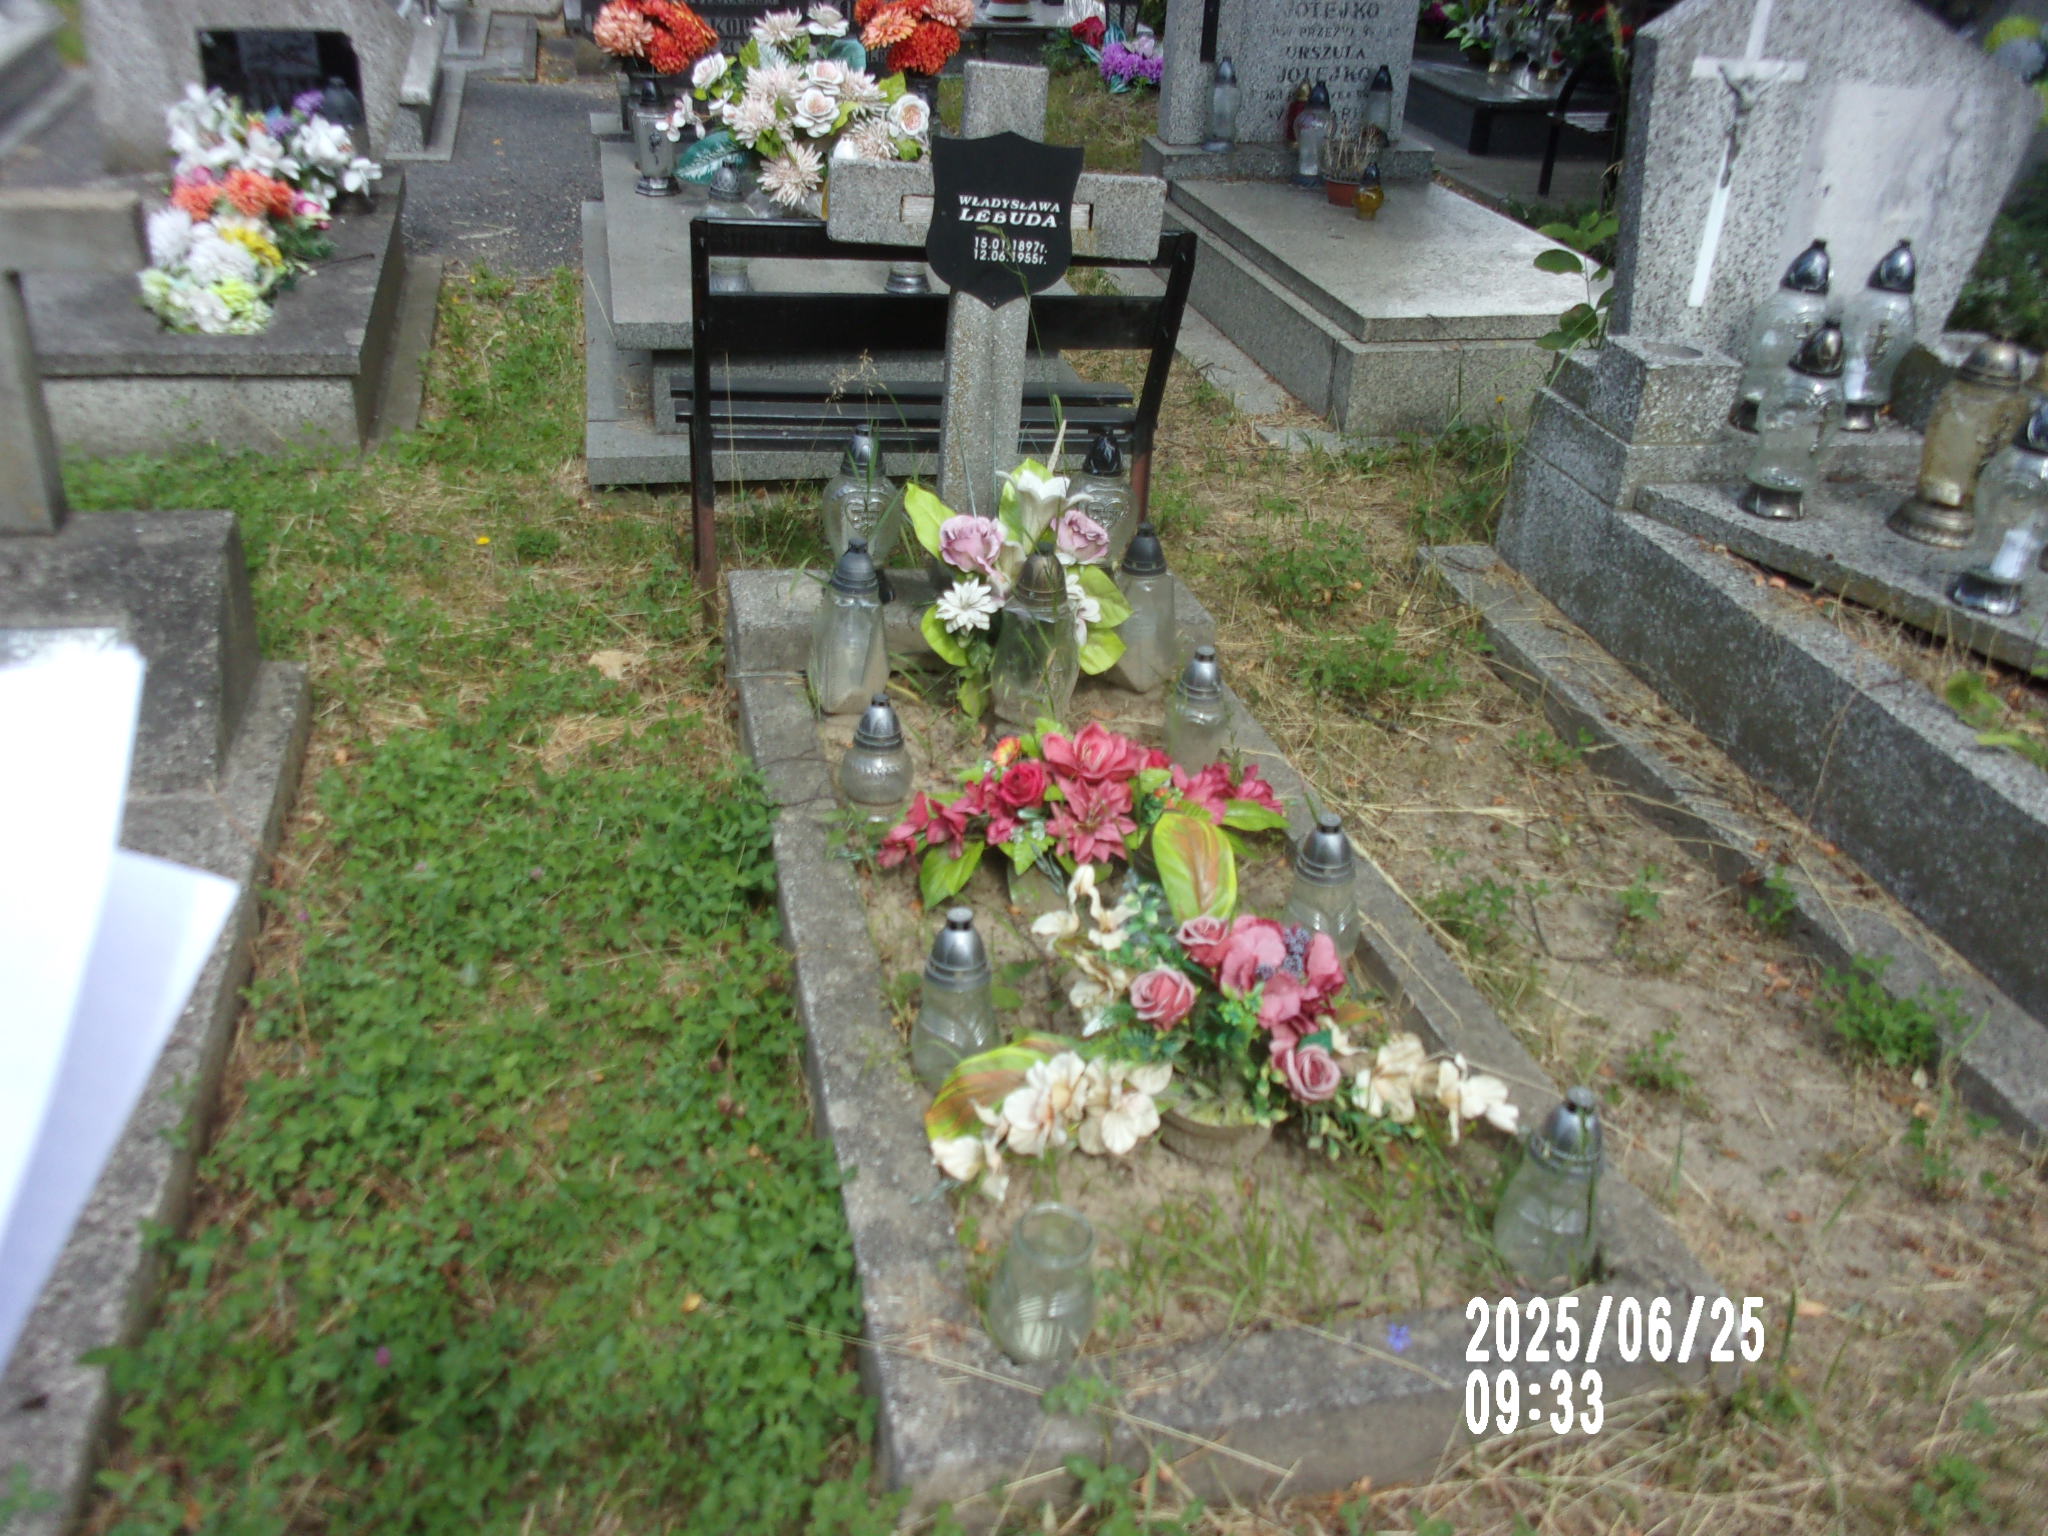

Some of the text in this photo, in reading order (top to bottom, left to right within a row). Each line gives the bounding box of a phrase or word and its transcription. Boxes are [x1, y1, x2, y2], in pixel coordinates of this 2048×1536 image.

[958, 194, 1060, 213] WŁADYSŁAWA
[958, 207, 1058, 228] LEBUDA
[973, 248, 1047, 265] 12.06.1955r.
